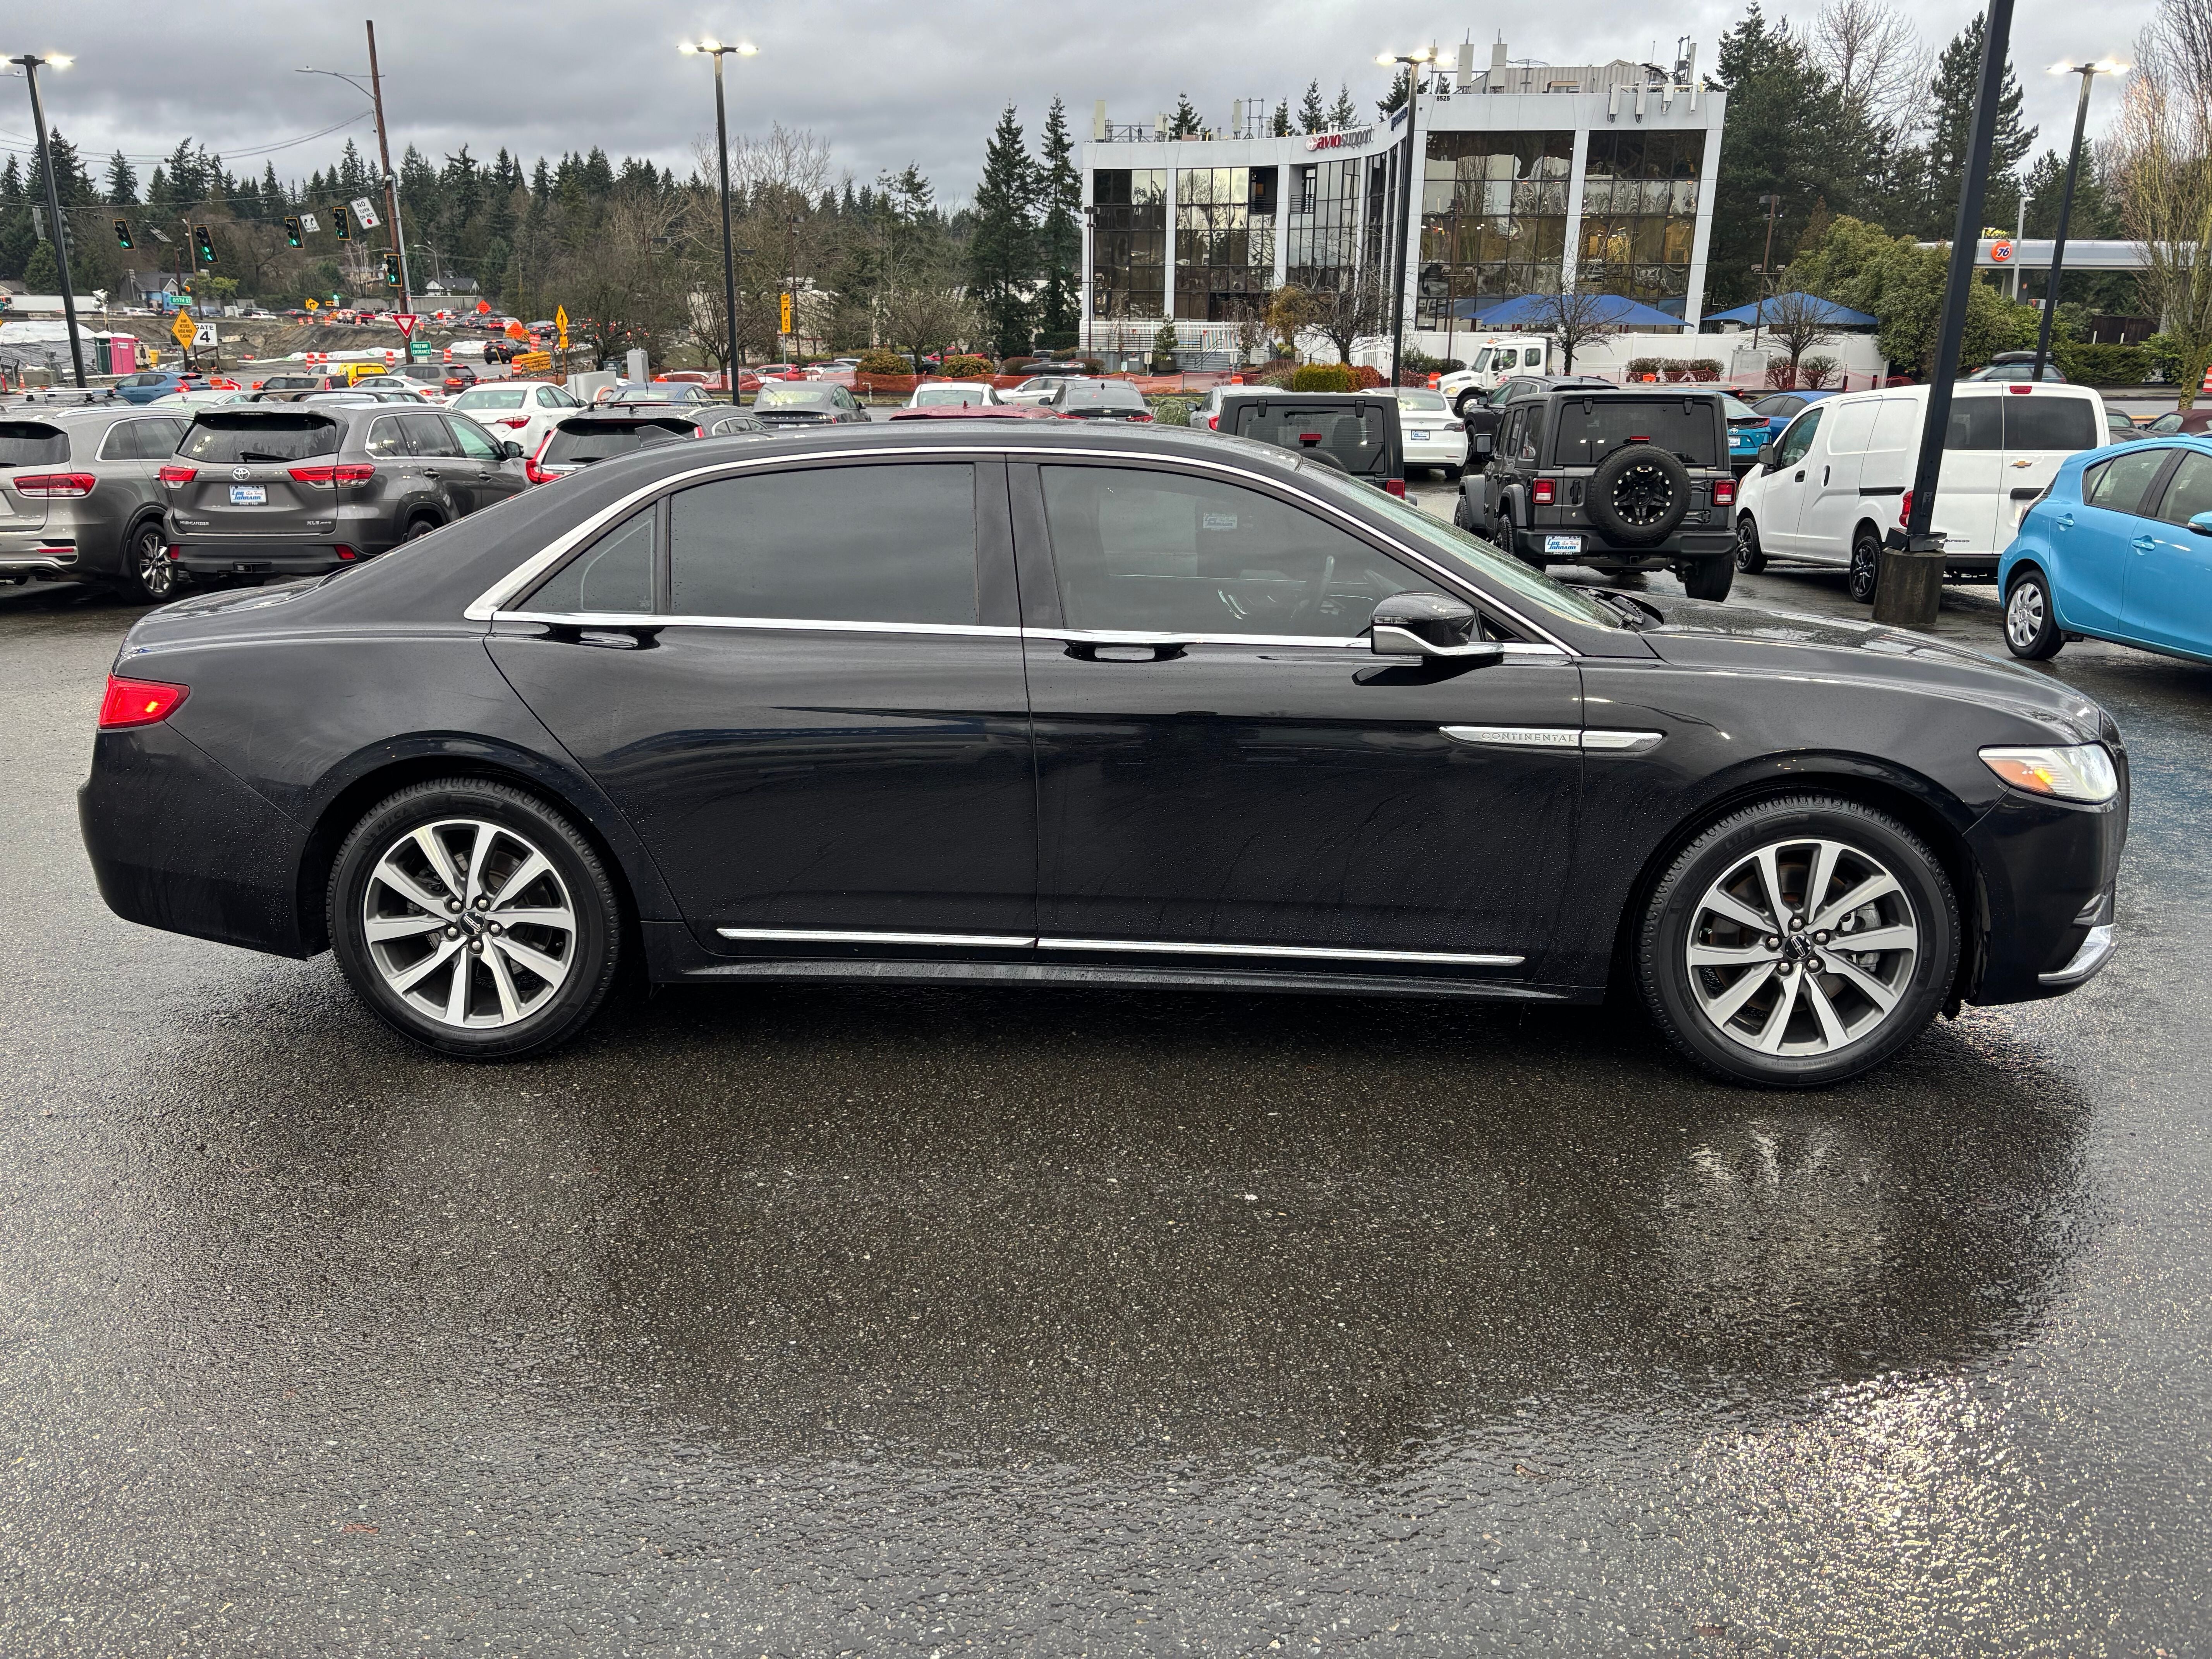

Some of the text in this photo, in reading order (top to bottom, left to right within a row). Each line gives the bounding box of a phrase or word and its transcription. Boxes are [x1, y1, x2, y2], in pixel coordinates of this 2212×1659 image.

[1996, 247, 2010, 258] 76
[199, 331, 211, 343] 4
[1482, 733, 1574, 742] CONTINENTAL
